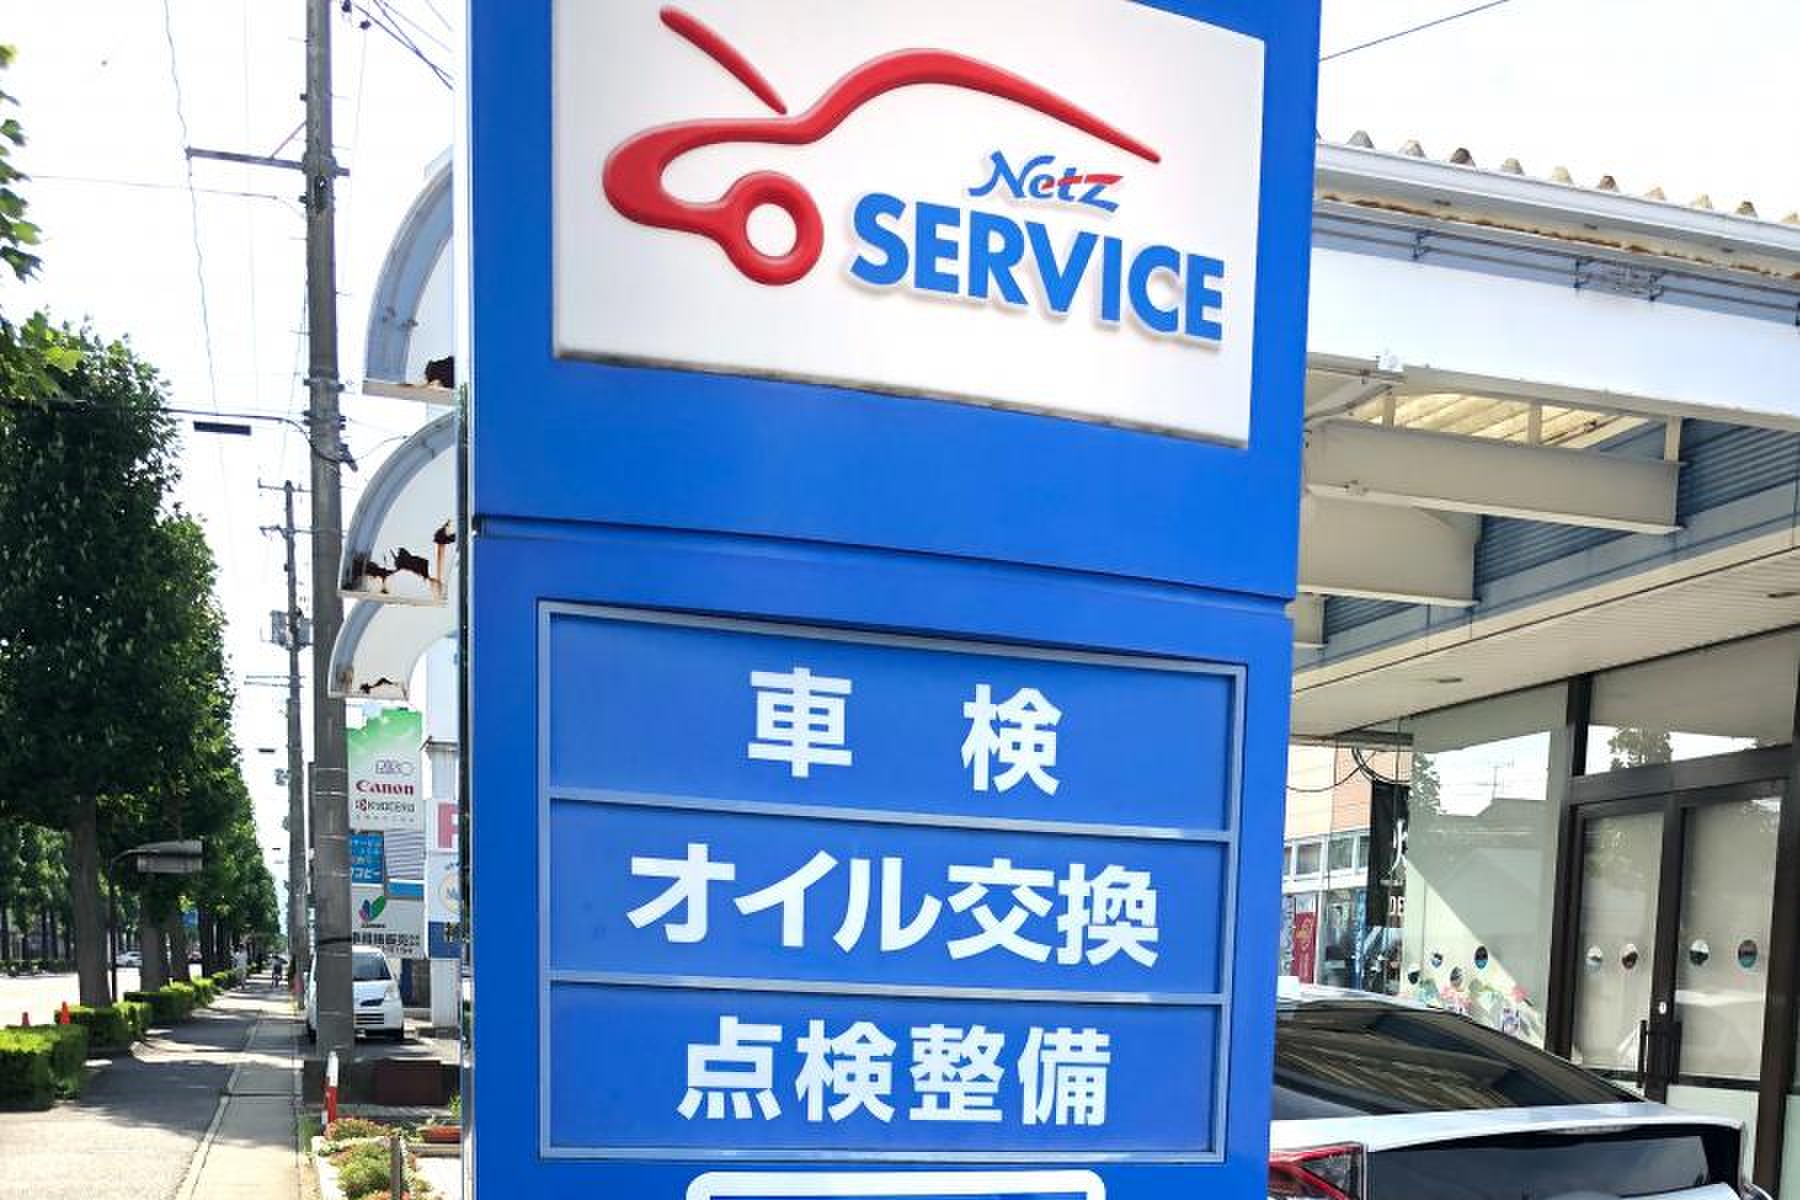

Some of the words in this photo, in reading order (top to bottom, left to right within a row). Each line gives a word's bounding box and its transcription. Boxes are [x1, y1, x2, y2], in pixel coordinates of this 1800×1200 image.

[851, 193, 1225, 342] SERVICE
[355, 779, 414, 795] Canon
[626, 842, 1160, 967] オイル交換
[677, 1015, 1111, 1126] 点検整備
